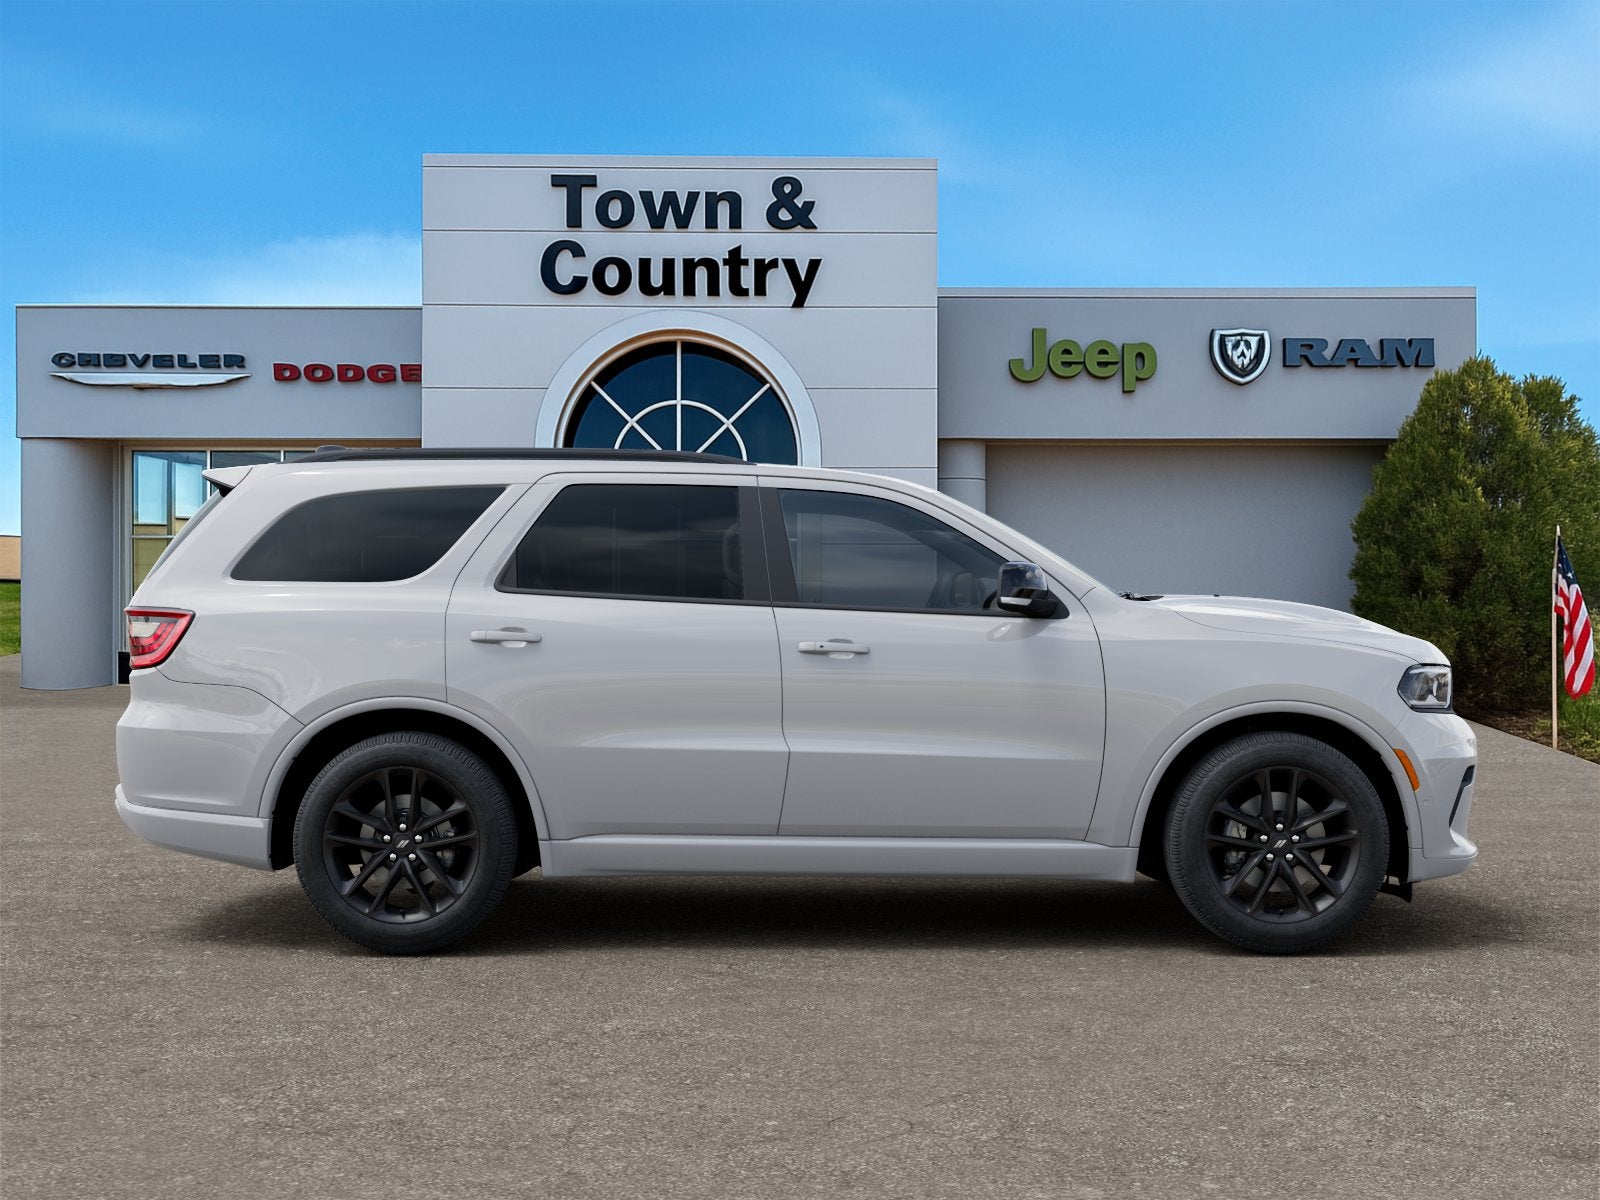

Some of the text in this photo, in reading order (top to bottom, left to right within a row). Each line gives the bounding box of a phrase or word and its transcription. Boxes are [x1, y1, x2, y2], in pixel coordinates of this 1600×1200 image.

[551, 174, 818, 230] Town &
[540, 239, 822, 308] Country
[273, 363, 422, 383] DODGE
[1009, 328, 1157, 392] Jeep
[1282, 337, 1436, 368] RAM
